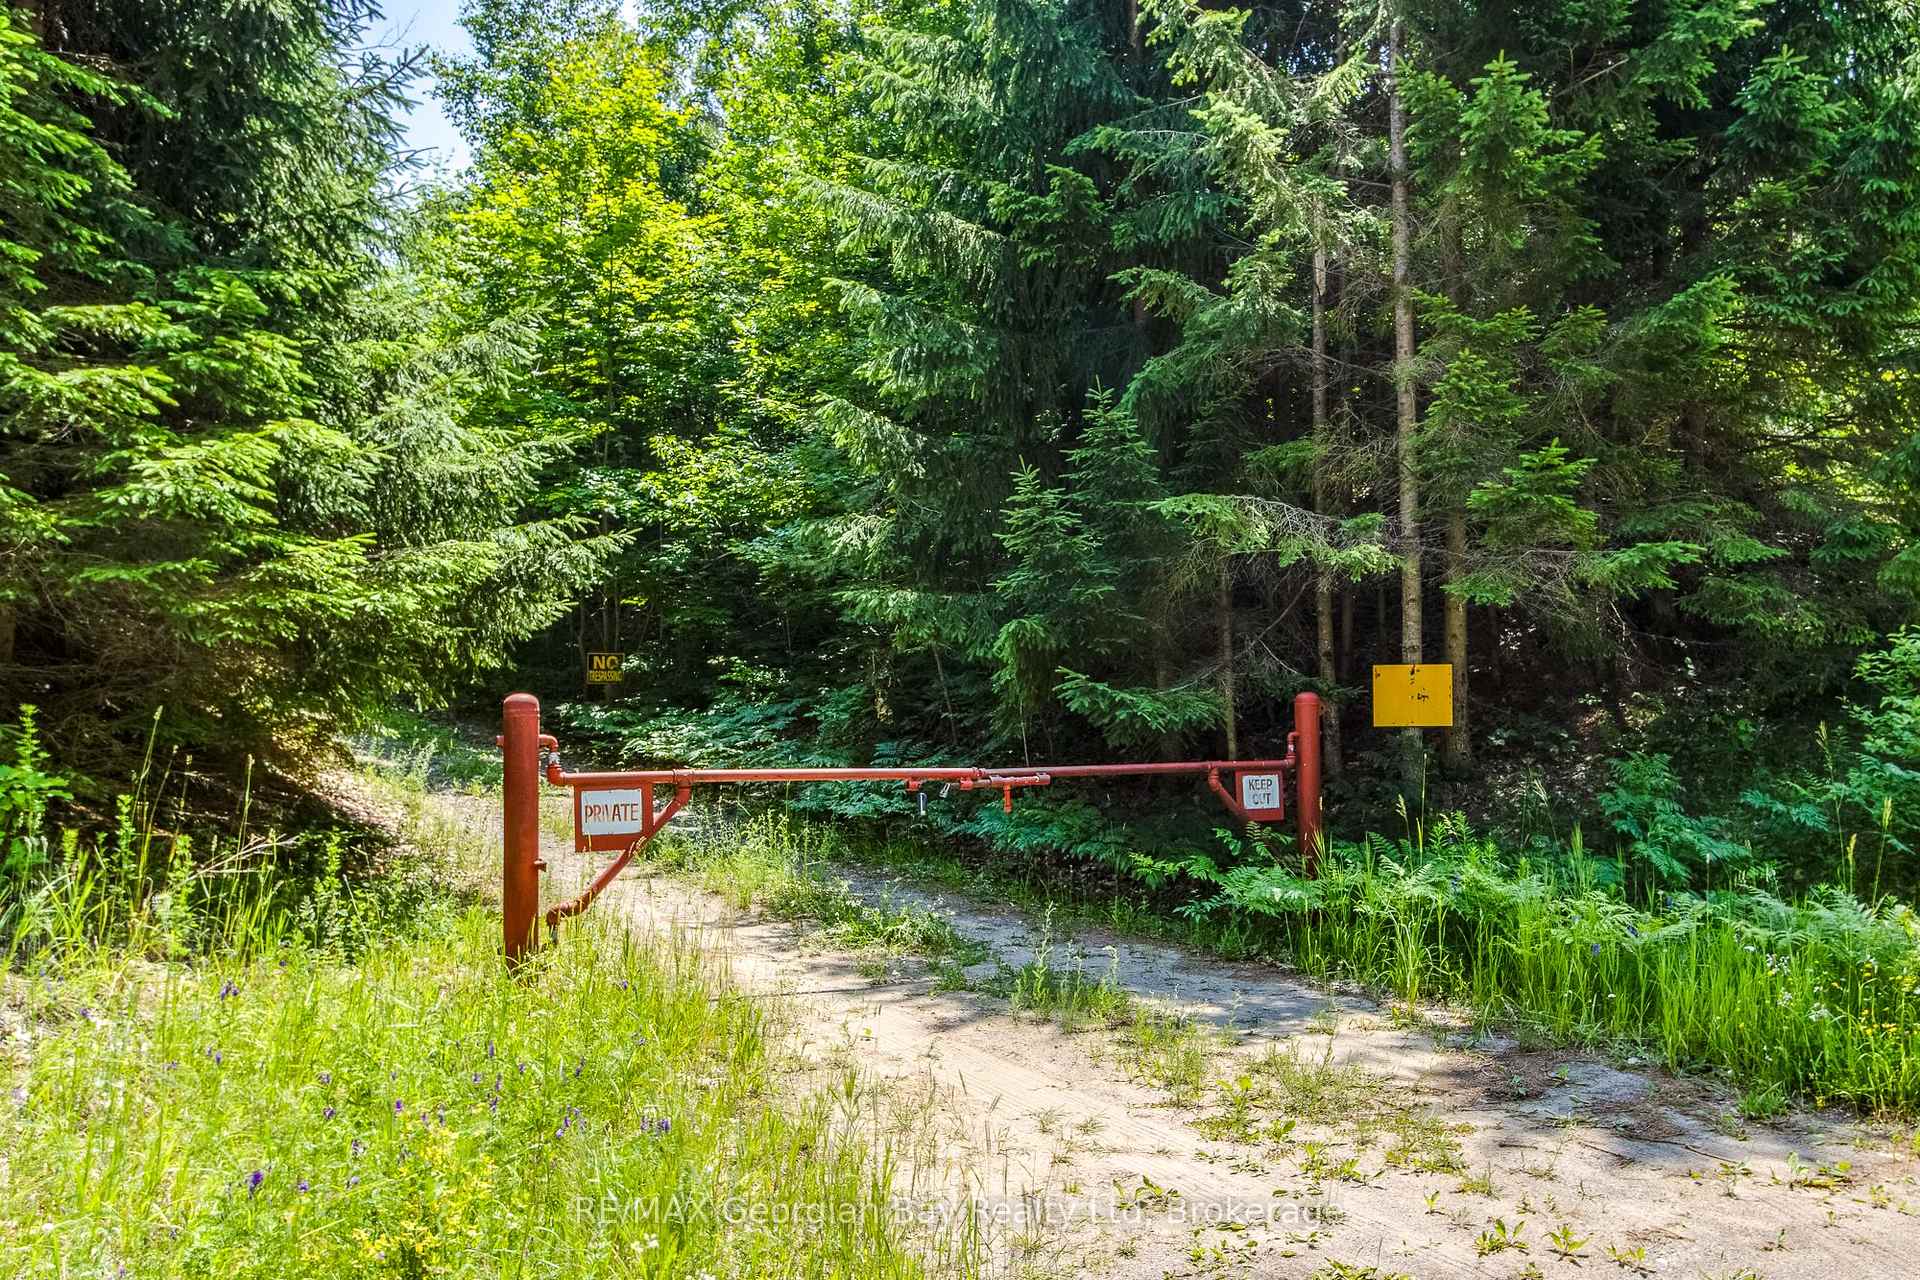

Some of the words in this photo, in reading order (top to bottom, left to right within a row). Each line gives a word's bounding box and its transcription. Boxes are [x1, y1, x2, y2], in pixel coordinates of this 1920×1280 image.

[593, 655, 619, 670] NO
[1248, 778, 1273, 791] KEEP
[584, 803, 639, 823] PRIVATE
